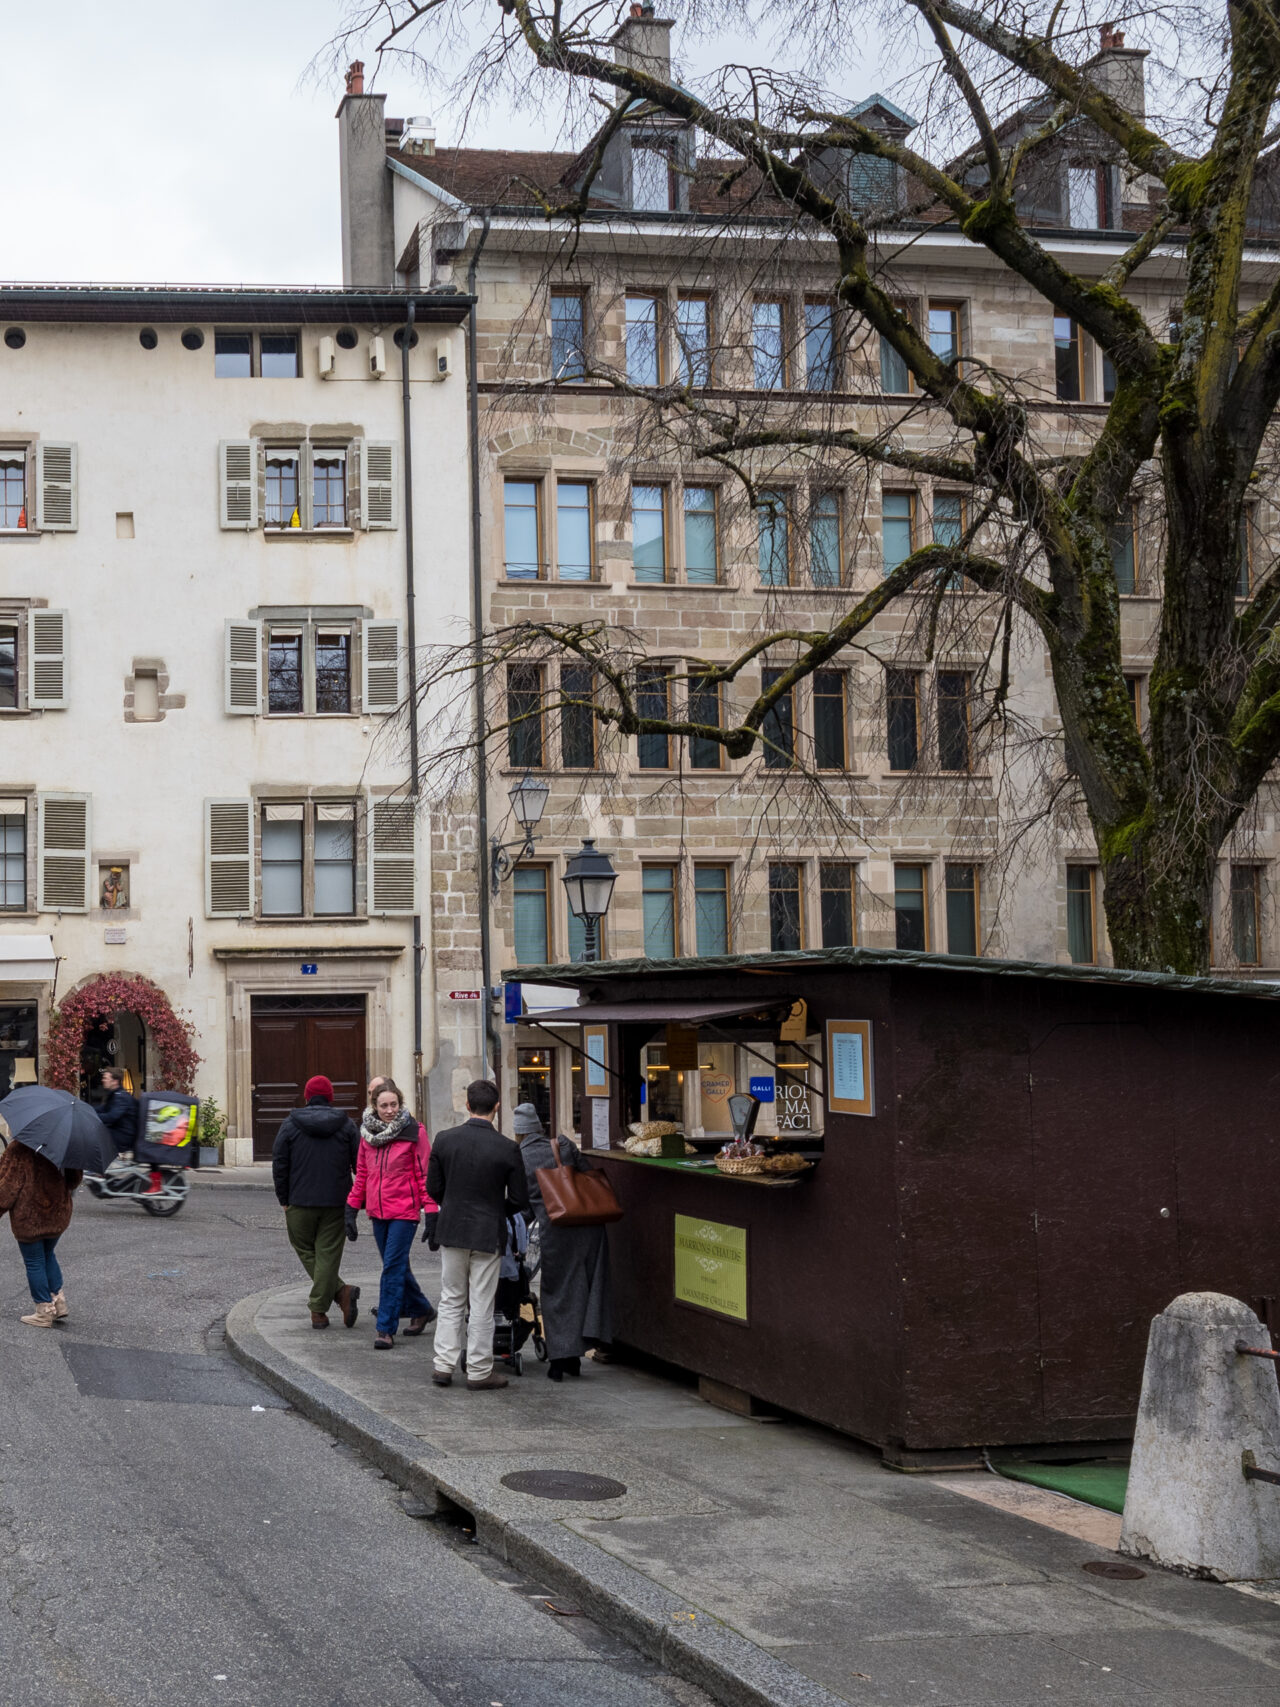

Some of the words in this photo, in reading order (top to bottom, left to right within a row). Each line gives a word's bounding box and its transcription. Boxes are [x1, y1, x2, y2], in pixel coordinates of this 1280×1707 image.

[306, 965, 312, 973] 7
[454, 991, 469, 999] Rive
[701, 1080, 730, 1088] CRAMER
[785, 1100, 810, 1114] MA
[679, 1237, 711, 1255] MARRONS
[712, 1246, 742, 1262] CHAUDS
